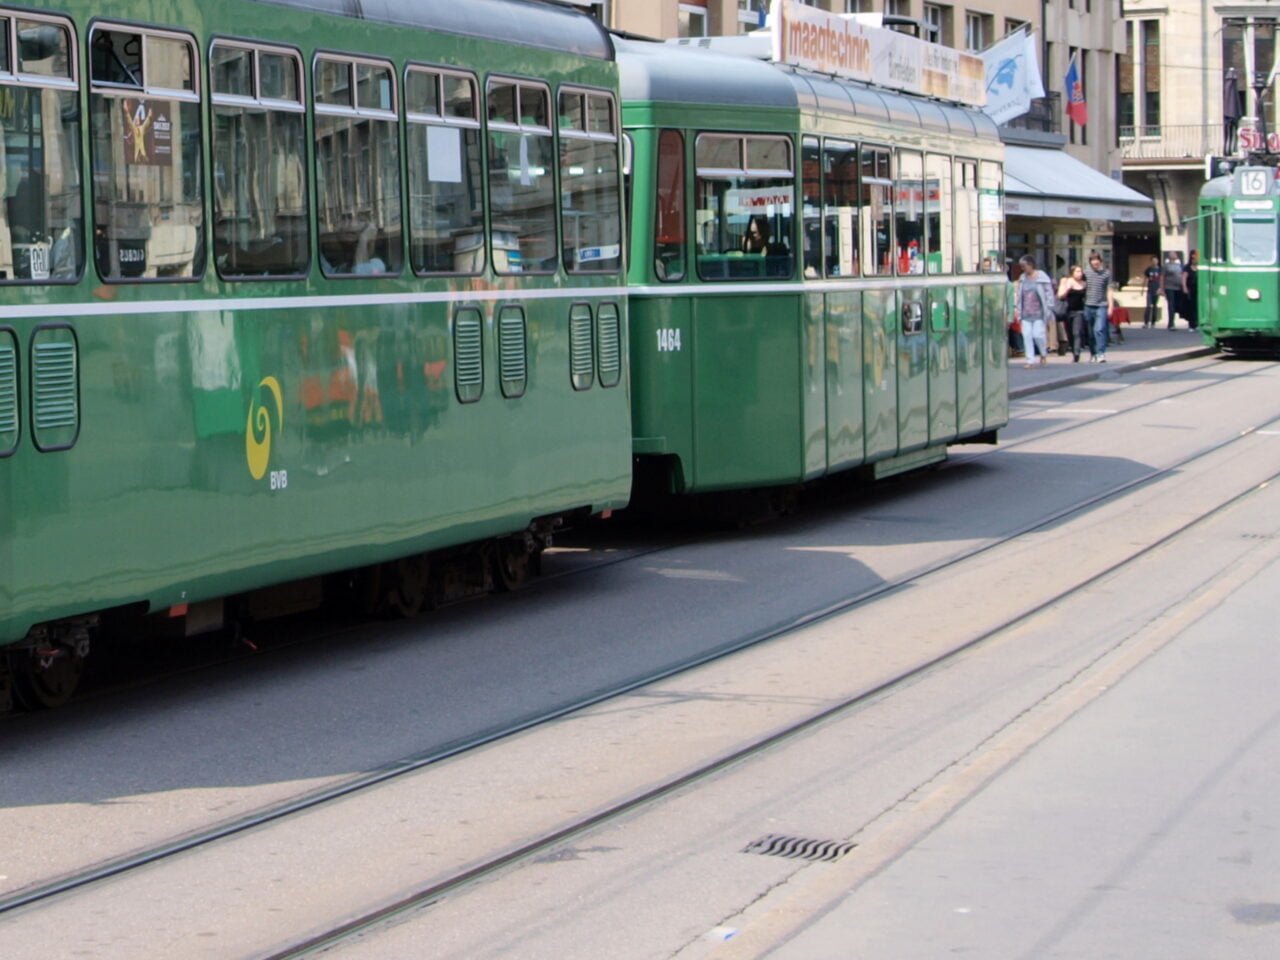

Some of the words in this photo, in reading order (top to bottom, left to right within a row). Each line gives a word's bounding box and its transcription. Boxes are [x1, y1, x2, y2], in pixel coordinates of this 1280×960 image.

[789, 18, 870, 72] maagtechnic
[1244, 172, 1263, 191] 16
[656, 328, 682, 352] 1464
[270, 470, 288, 490] BVB
